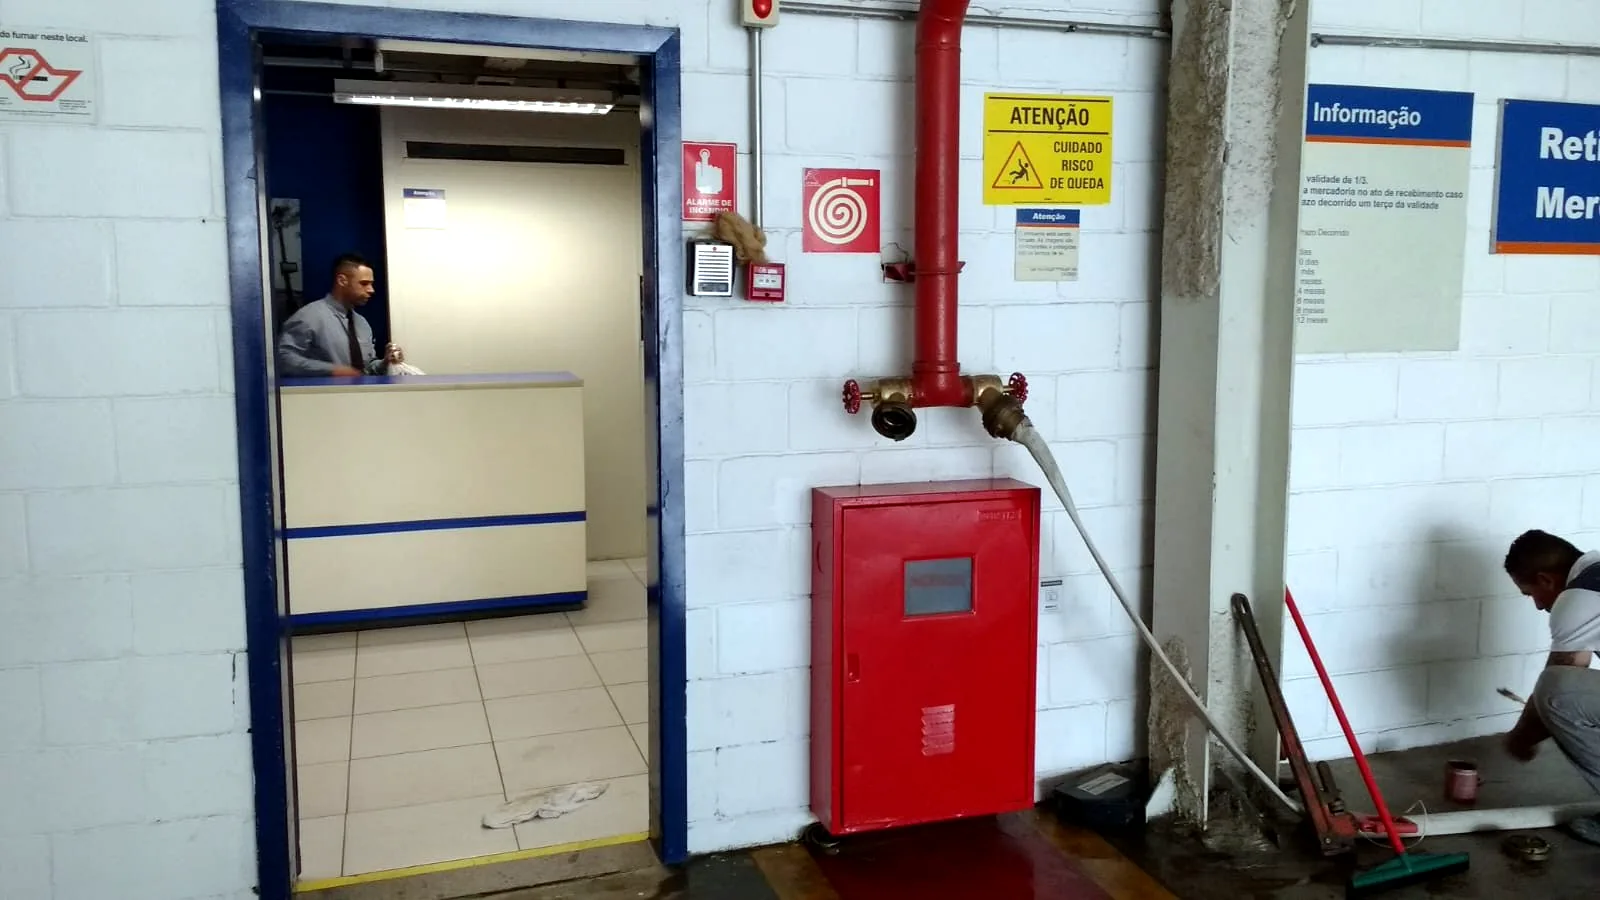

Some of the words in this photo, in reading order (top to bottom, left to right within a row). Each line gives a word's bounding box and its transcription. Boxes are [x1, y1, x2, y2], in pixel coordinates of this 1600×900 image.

[12, 31, 38, 39] fumar
[41, 33, 64, 41] neste
[1011, 104, 1089, 130] ATENÇÃO
[1314, 102, 1421, 129] Informação
[1054, 142, 1102, 154] CUIDADO
[1540, 127, 1600, 161] Ret
[1062, 160, 1093, 171] RISCO
[1050, 178, 1064, 189] DE
[1068, 178, 1104, 189] QUEDA
[1306, 175, 1341, 184] validade
[1343, 176, 1352, 184] de
[1311, 187, 1356, 196] mercadoria
[1384, 189, 1394, 197] de
[1396, 189, 1444, 198] recebimento
[687, 198, 720, 206] ALARME
[1318, 199, 1357, 207] decorrido
[1374, 200, 1393, 210] terço
[1407, 201, 1440, 209] validade
[1536, 187, 1600, 219] Mer
[1032, 213, 1066, 221] Atenção
